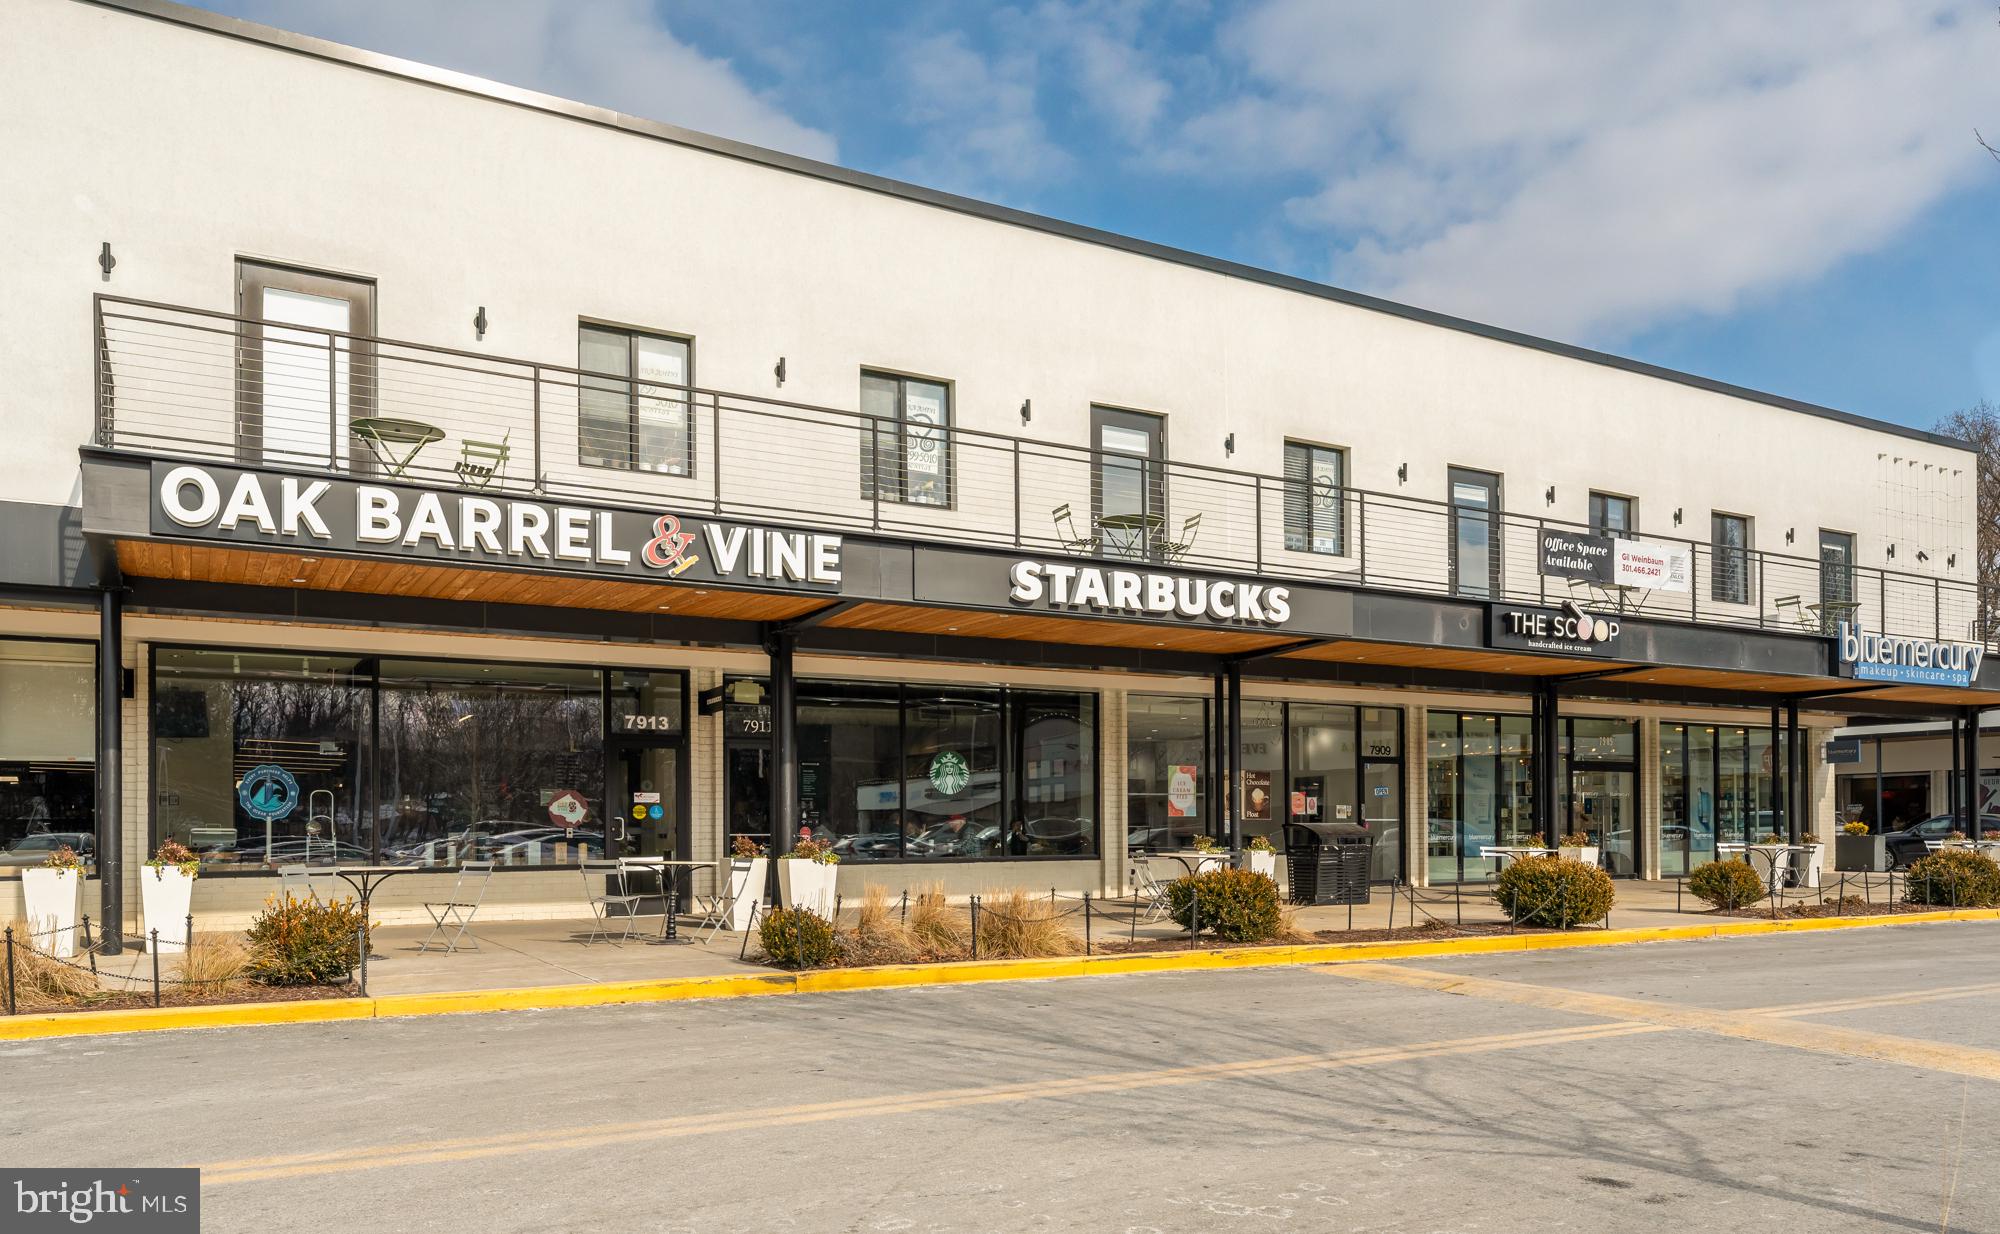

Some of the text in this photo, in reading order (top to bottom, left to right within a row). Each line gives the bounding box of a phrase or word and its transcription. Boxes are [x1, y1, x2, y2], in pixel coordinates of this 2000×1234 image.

[160, 466, 842, 585] OAK BARREL & VINE
[1544, 537, 1608, 557] Office Space
[1544, 554, 1593, 572] Available
[1621, 552, 1664, 566] Gil Weinbaum
[1621, 564, 1661, 577] 301.466.2421
[1009, 560, 1291, 625] STARBUCKS
[1510, 611, 1620, 642] THE SCOOP
[1528, 639, 1563, 650] handcrafted
[1564, 643, 1573, 651] ice
[1839, 620, 1985, 682] bluemercury
[1860, 664, 1967, 684] makeup skincare spa
[624, 714, 669, 730] 7913
[743, 719, 772, 734] 7911
[1369, 745, 1391, 756] 7909
[1375, 787, 1388, 796] OPEN
